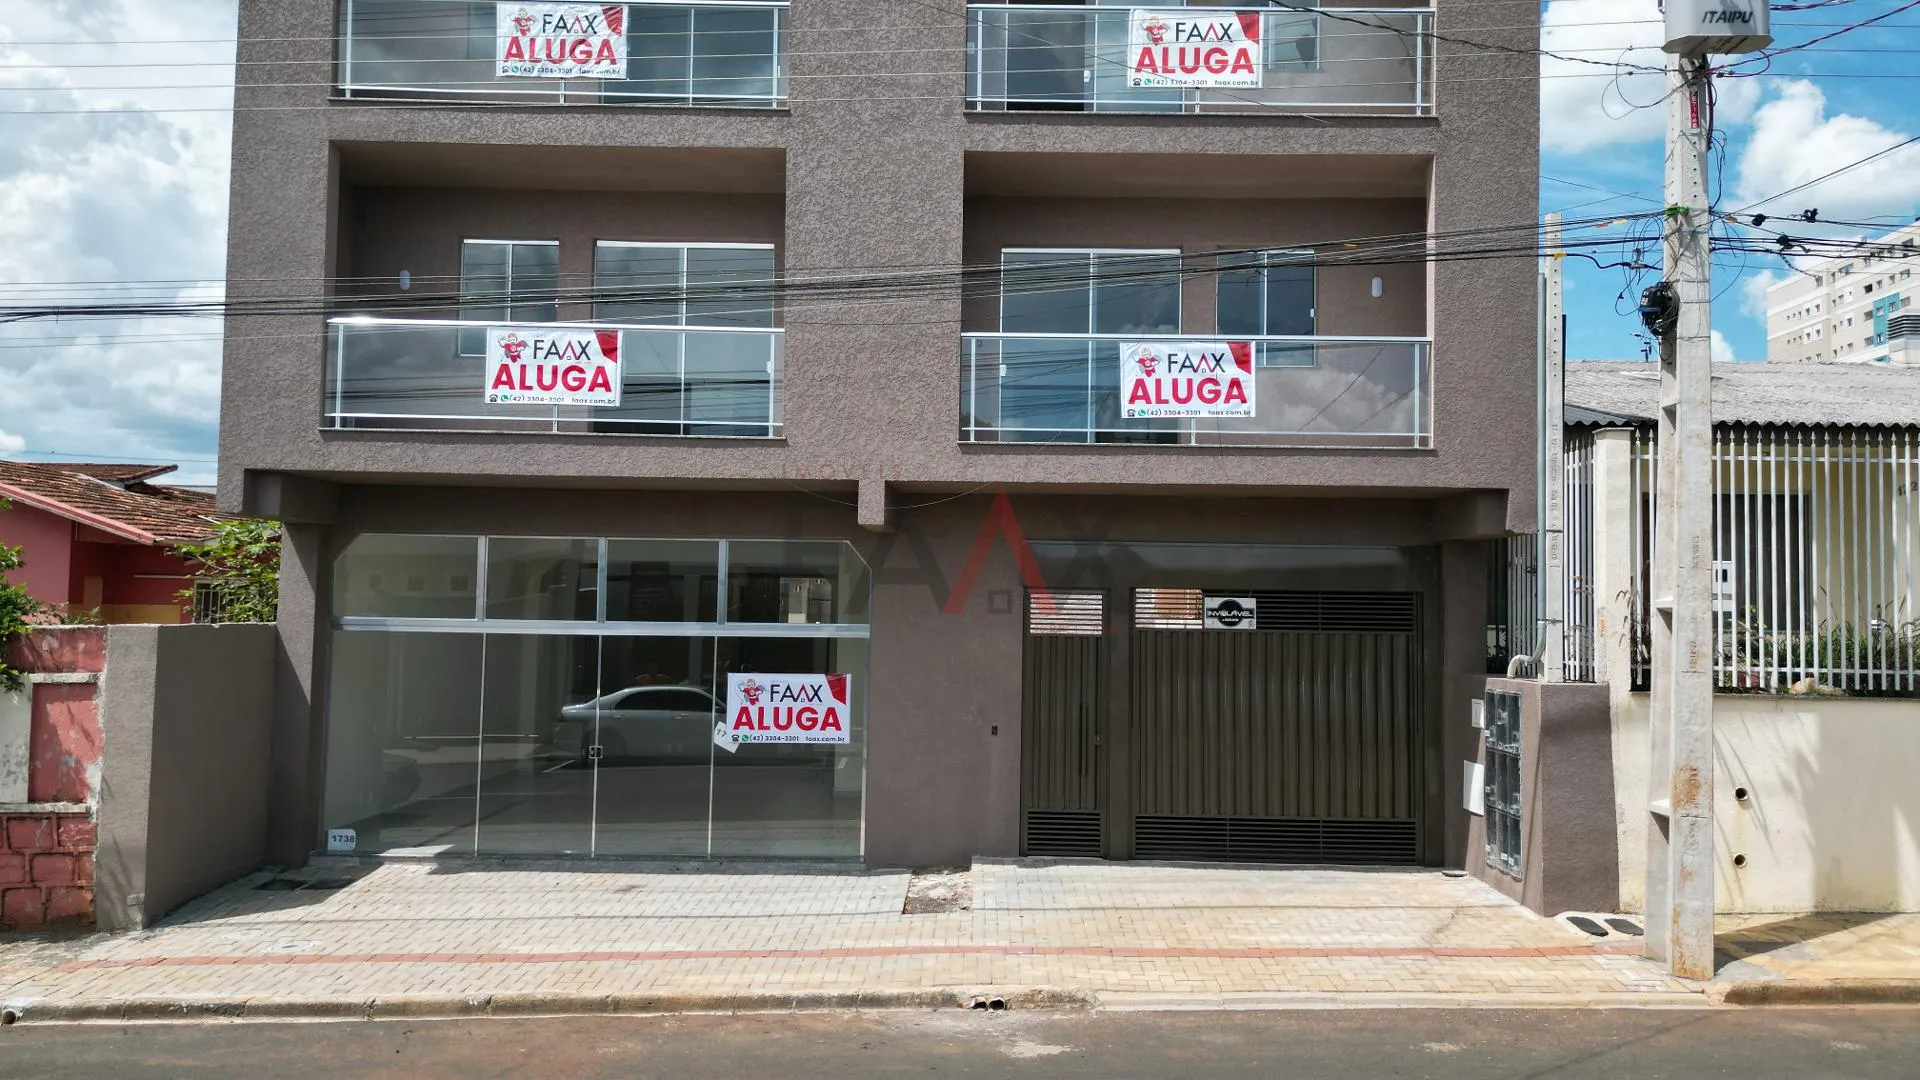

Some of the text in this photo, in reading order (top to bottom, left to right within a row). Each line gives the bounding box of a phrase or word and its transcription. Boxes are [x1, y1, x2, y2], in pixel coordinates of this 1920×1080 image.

[542, 14, 598, 34] FAAX
[1701, 11, 1753, 24] ITAIPU
[1175, 22, 1233, 42] FAAX
[503, 36, 617, 65] ALUGA
[1135, 46, 1254, 74] ALUGA
[533, 339, 592, 361] FAAX
[1167, 352, 1226, 374] FAAX
[491, 363, 613, 392] ALUGA
[509, 394, 525, 402] (42)
[1128, 377, 1248, 405] ALUGA
[769, 683, 823, 703] FAAX
[733, 706, 842, 731] ALUGA
[750, 734, 764, 742] (42)
[331, 834, 355, 843] 1738
